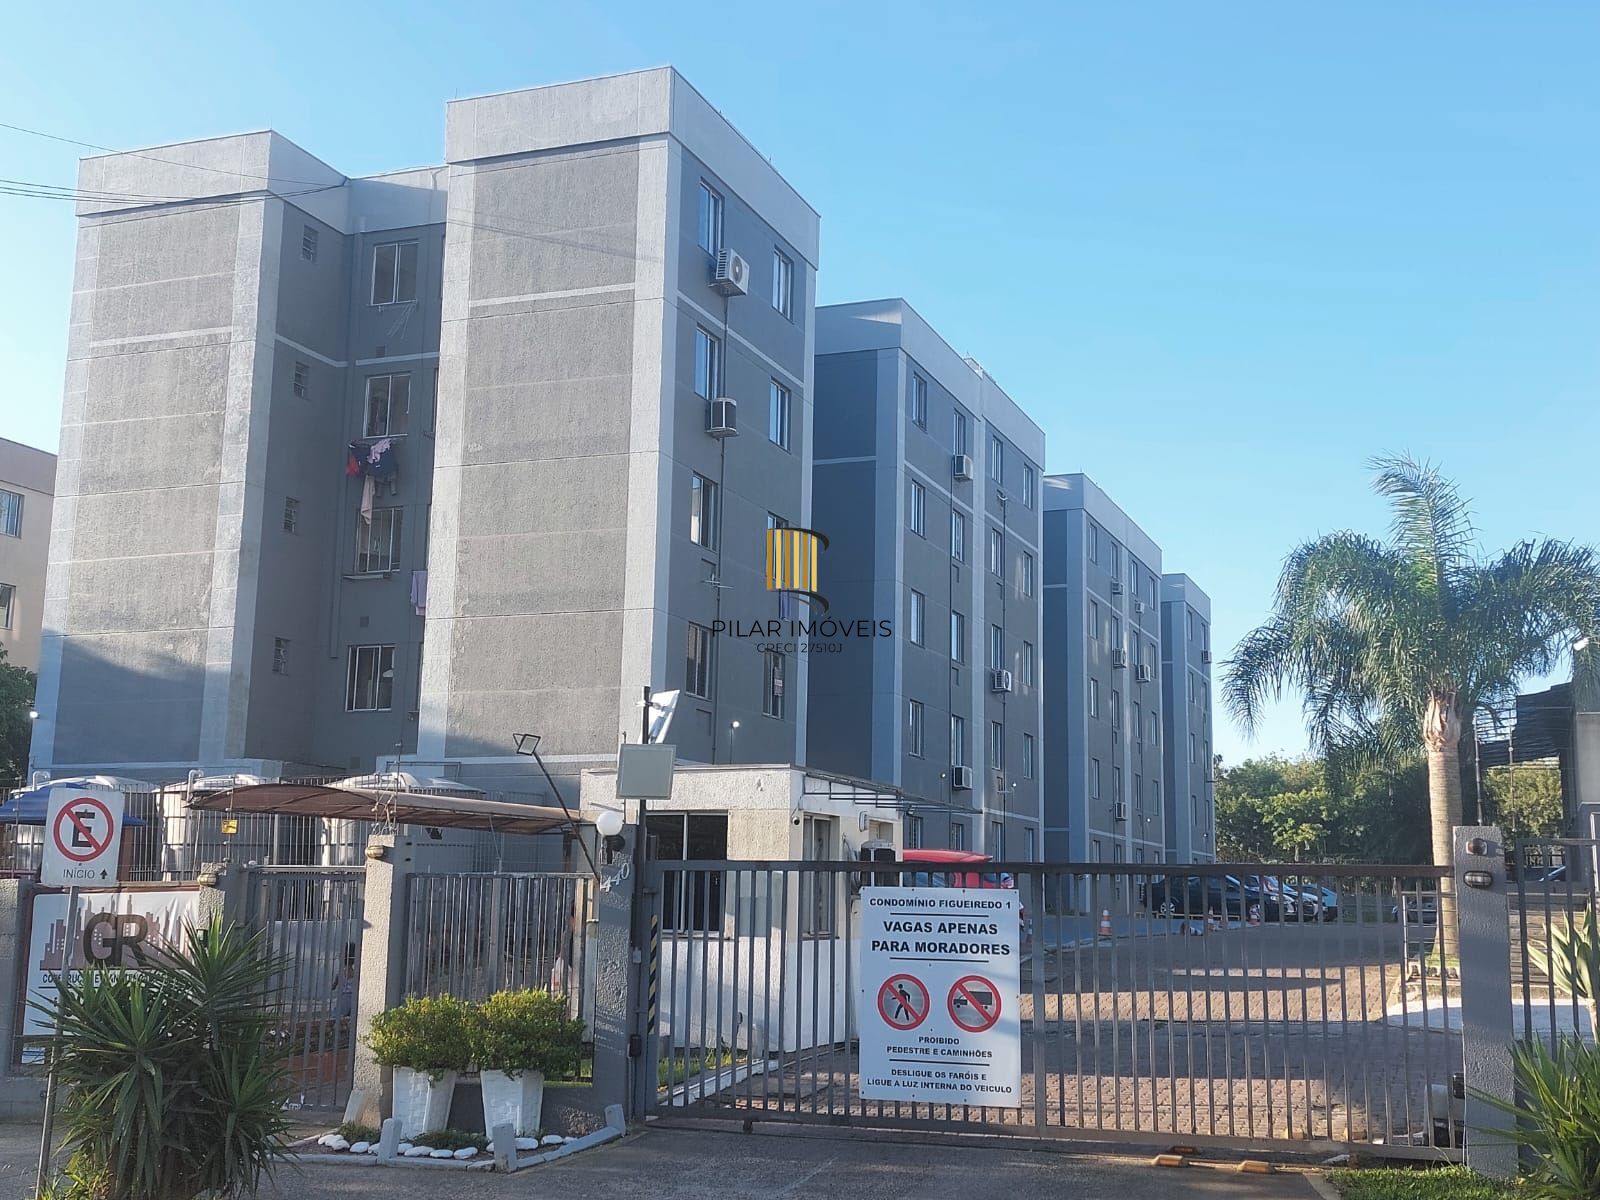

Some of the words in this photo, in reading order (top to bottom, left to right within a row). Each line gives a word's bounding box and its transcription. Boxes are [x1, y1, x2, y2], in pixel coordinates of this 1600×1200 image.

[63, 867, 95, 879] INÍCIO
[870, 896, 936, 908] CONDOMÍNIO
[939, 900, 1002, 909] FIGUEIREDO
[1006, 901, 1011, 909] 1
[883, 921, 933, 933] VAGAS
[937, 922, 998, 935] APENAS
[871, 940, 910, 953] PARA
[915, 941, 1010, 955] MORADORES
[918, 1036, 960, 1045] PROIBIDO
[886, 1046, 930, 1055] PEDESTRE
[891, 1068, 932, 1078] DESLIGUE
[934, 1071, 946, 1079] OS
[949, 1070, 979, 1080] FARÓIS
[867, 1078, 892, 1087] LIGUE
[902, 1080, 918, 1088] LUZ
[920, 1081, 958, 1091] INTERNA
[960, 1083, 972, 1091] DO
